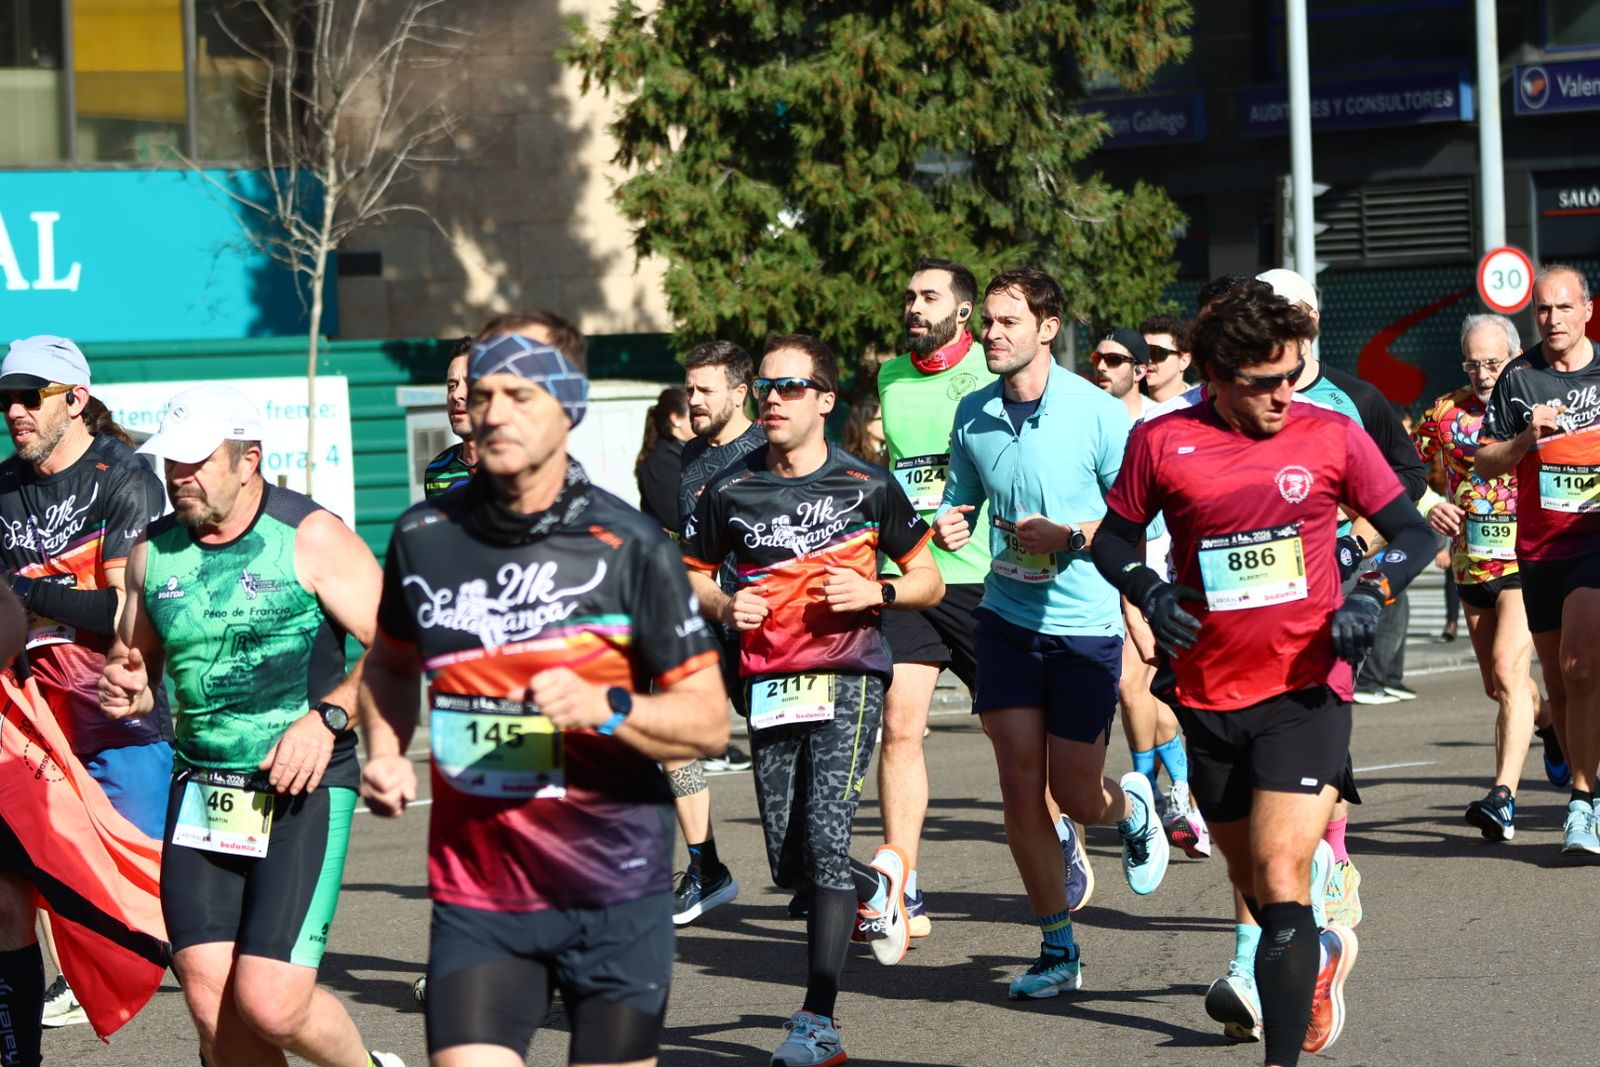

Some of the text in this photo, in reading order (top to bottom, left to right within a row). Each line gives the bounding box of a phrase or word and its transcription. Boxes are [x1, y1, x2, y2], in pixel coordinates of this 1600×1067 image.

[1556, 73, 1600, 97] Valen
[1249, 89, 1454, 123] AUDITES Y CONSULTORES
[1132, 110, 1187, 136] Gallego
[1491, 269, 1522, 290] 30
[266, 400, 336, 421] frene:
[325, 444, 340, 465] 4
[905, 467, 946, 486] 1024
[1553, 475, 1596, 491] 1104
[46, 490, 84, 532] 21k
[797, 494, 841, 527] 21k
[744, 519, 850, 551] Salamanca
[1480, 525, 1511, 538] 639
[1227, 547, 1276, 572] 886
[158, 591, 186, 600] VIATOR
[497, 560, 572, 607] 21k
[232, 607, 245, 617] de
[249, 606, 291, 617] Francia
[417, 588, 579, 641] Salamanca
[766, 673, 818, 698] 2117
[466, 721, 524, 748] 145
[226, 775, 245, 785] 2026
[206, 790, 234, 813] 46
